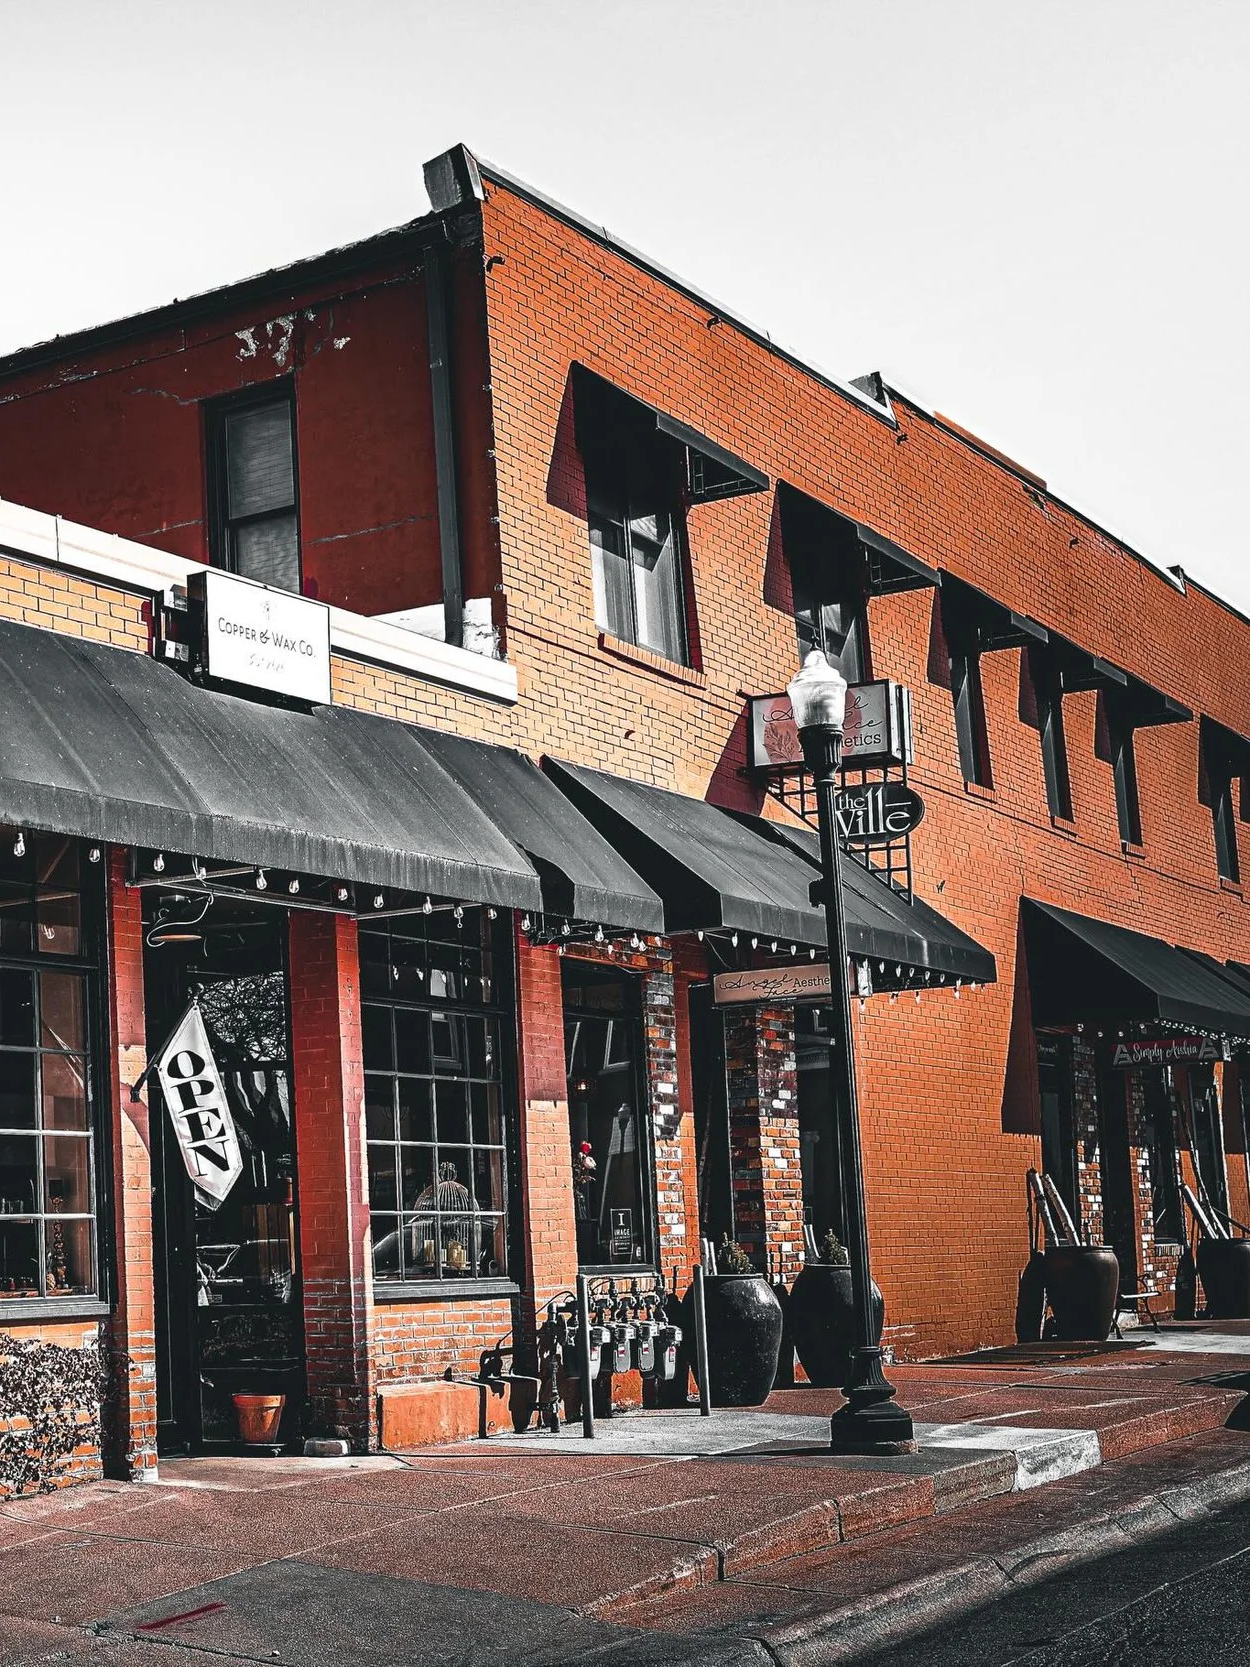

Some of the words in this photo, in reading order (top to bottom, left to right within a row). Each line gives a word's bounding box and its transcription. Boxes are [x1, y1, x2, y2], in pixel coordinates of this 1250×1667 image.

[218, 616, 257, 642] COPPER
[259, 629, 271, 645] &
[272, 631, 297, 652] WAX
[839, 793, 866, 810] the
[835, 786, 911, 839] Ville
[719, 973, 794, 991] Angel
[793, 976, 831, 988] Aesthe
[759, 985, 803, 999] Face
[1132, 1042, 1163, 1062] Simply
[166, 1049, 231, 1178] OPEN
